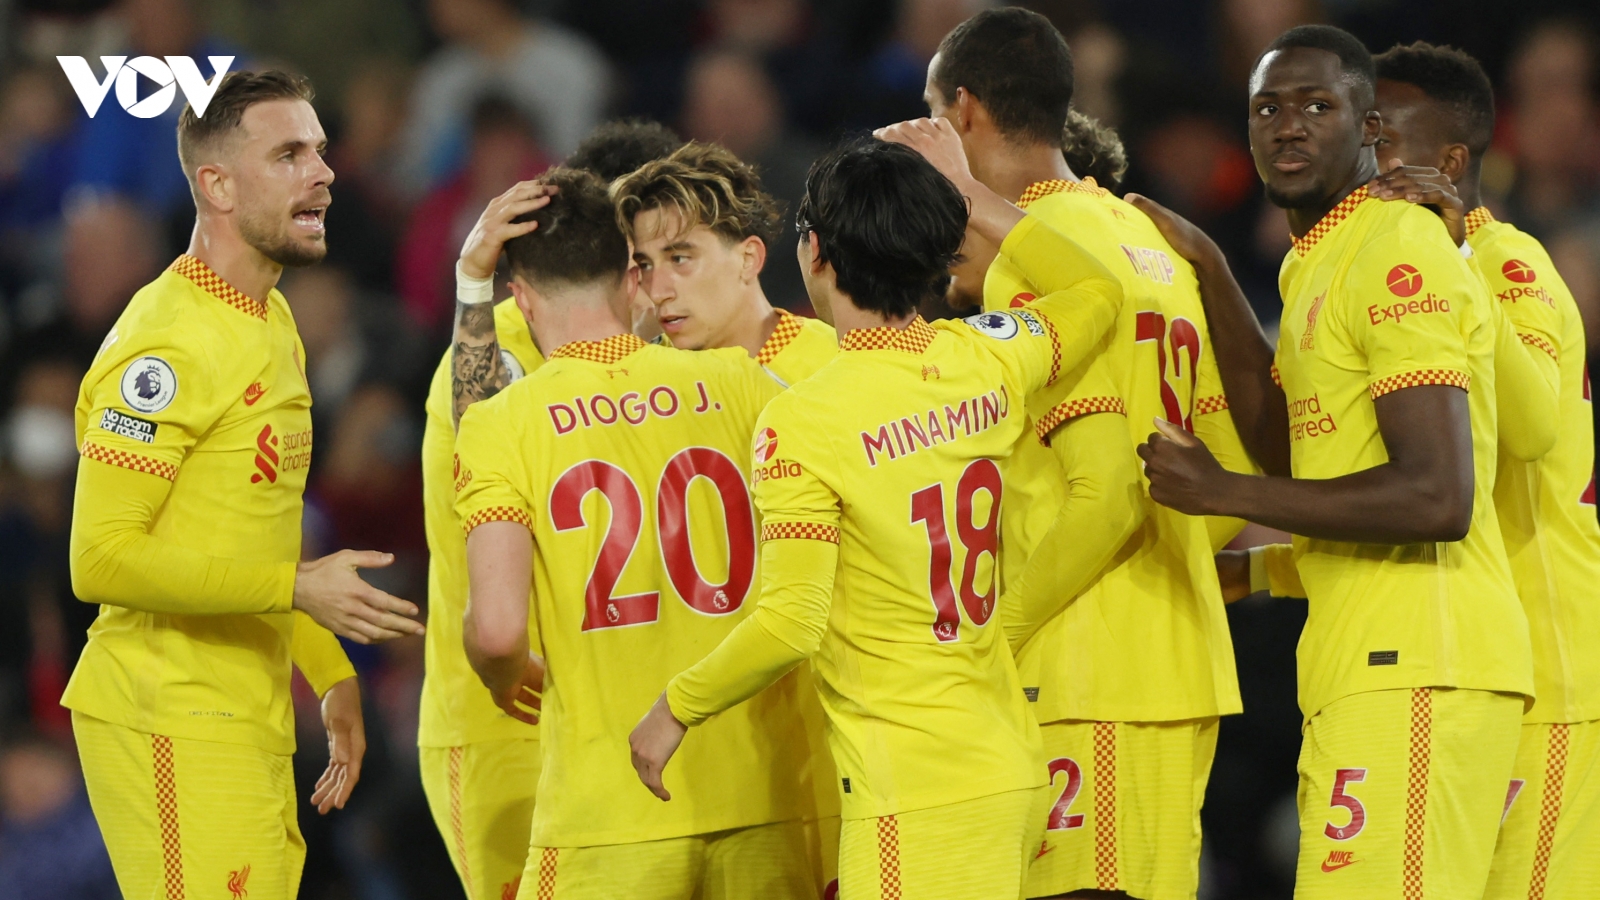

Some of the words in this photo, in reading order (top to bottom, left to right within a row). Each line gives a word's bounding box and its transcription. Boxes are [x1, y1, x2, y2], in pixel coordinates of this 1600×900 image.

[1368, 293, 1450, 326] Expedia
[1496, 286, 1556, 309] xpedia
[245, 382, 262, 396] NIKE
[102, 408, 119, 422] No
[119, 415, 152, 433] room
[548, 385, 680, 436] DIOGO
[694, 381, 723, 413] J.
[115, 423, 154, 444] racism
[859, 384, 1010, 467] MINAMINO
[752, 459, 802, 489] pedia
[548, 446, 757, 633] 20
[910, 458, 1003, 643] 18
[1047, 757, 1085, 831] 2
[1324, 768, 1368, 842] 5
[1327, 850, 1354, 863] NIKE
